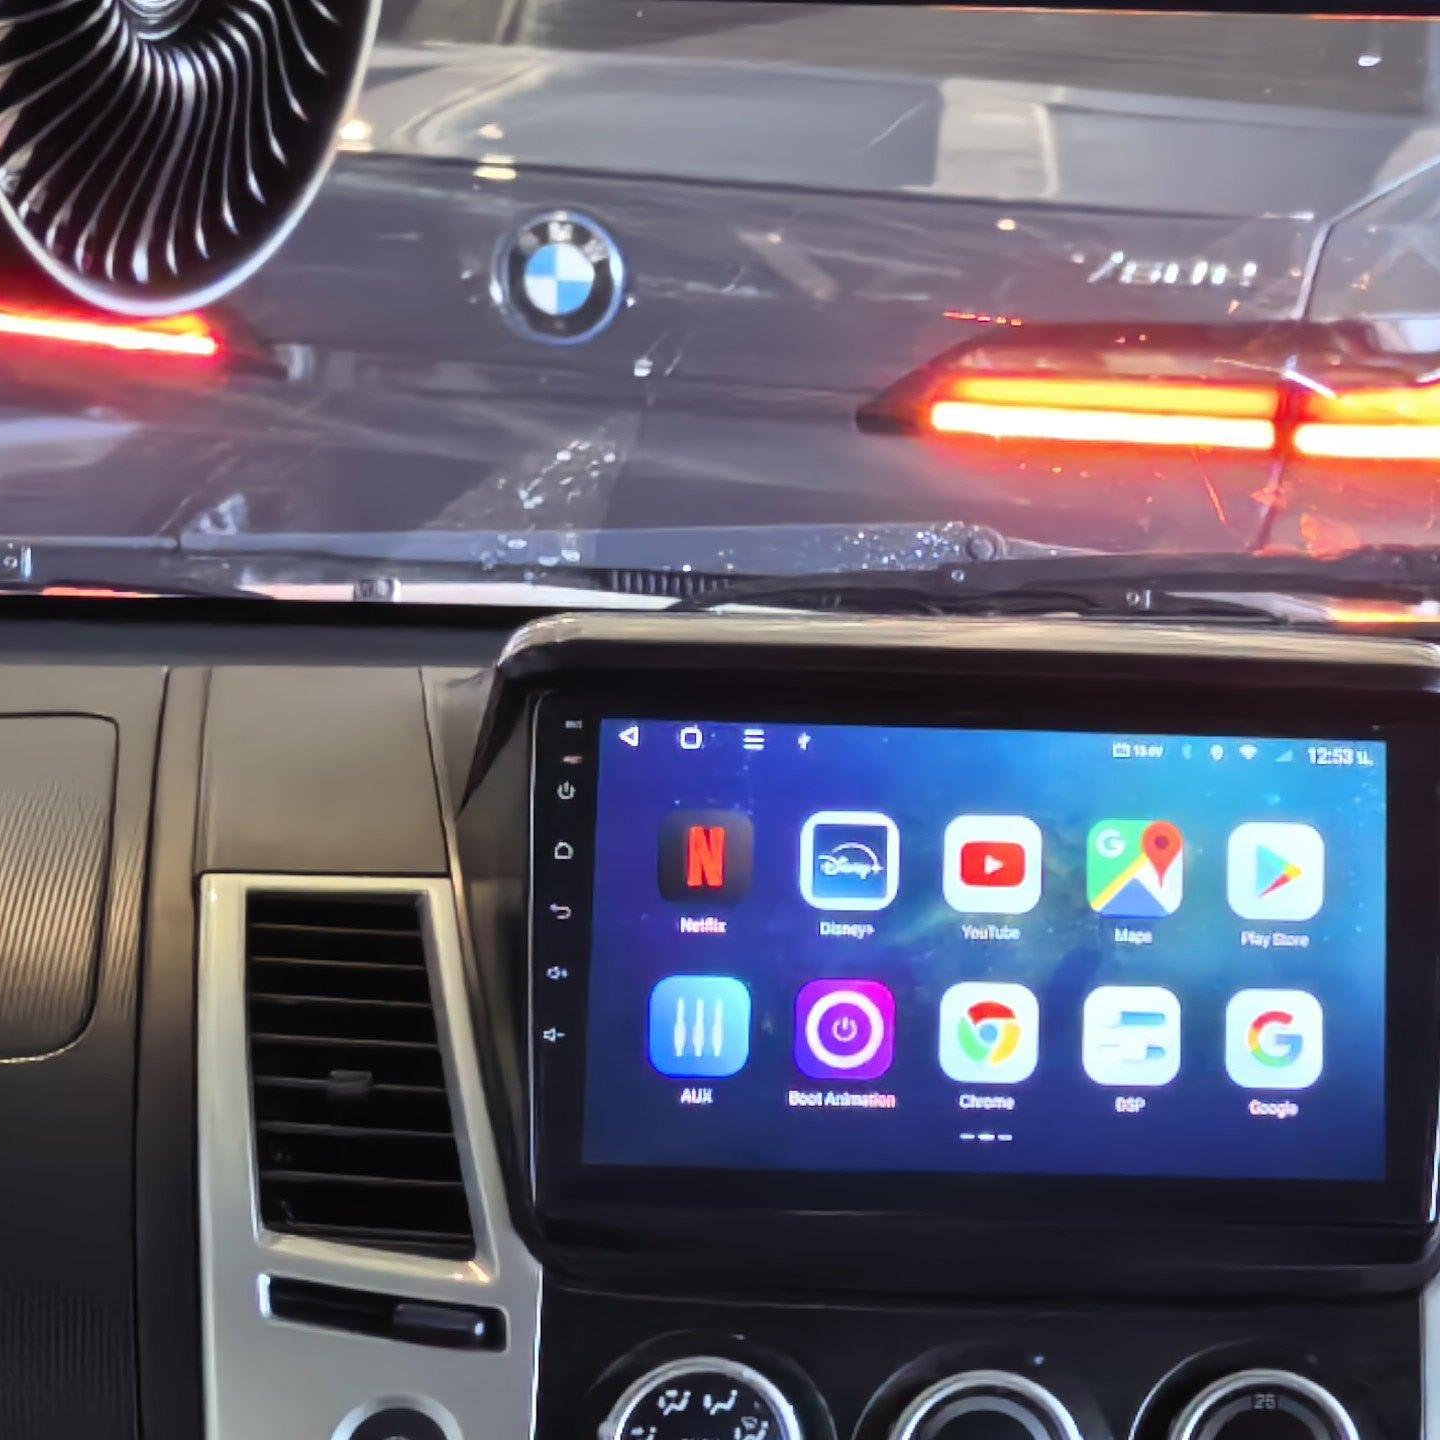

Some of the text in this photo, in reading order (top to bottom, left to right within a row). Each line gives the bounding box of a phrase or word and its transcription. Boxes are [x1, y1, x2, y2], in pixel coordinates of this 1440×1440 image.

[679, 917, 727, 935] Netflix
[961, 924, 1021, 941] YouTube
[1114, 928, 1153, 945] Maps
[1240, 931, 1310, 949] Play Store
[824, 1091, 897, 1109] Animation
[959, 1093, 1015, 1111] Chrome
[1248, 1098, 1300, 1119] Google
